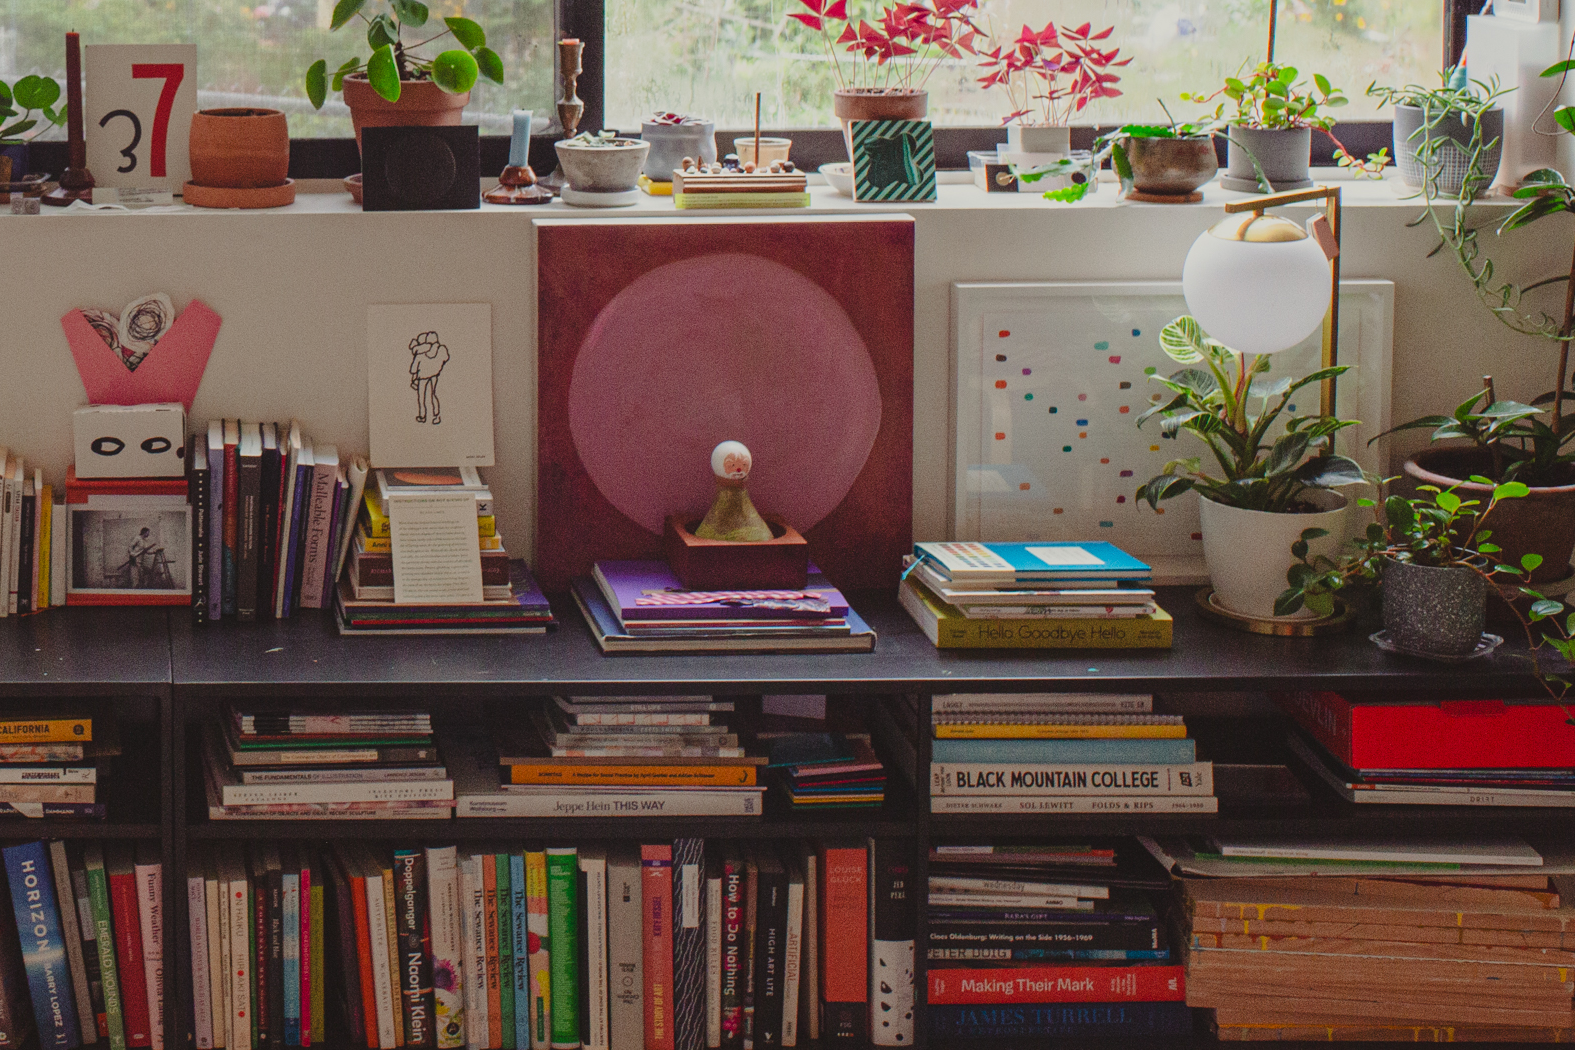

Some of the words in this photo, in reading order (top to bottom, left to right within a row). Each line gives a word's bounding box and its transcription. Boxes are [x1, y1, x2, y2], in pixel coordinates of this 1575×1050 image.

[98, 109, 142, 173] 3
[131, 63, 184, 177] 7
[312, 472, 330, 526] Malleable
[309, 528, 323, 563] Forms
[978, 624, 1013, 640] Hello
[1018, 624, 1086, 644] Goodbye
[1090, 625, 1126, 640] Hello
[264, 773, 311, 781] FUNDAMENTALS
[957, 771, 1006, 788] BLACK
[1011, 771, 1087, 788] MOUNTAIN
[1092, 771, 1159, 788] COLLEGE
[553, 801, 584, 814] Jeppe
[586, 800, 610, 811] Hein
[613, 800, 639, 811] THIS
[641, 800, 666, 810] WAY
[1470, 795, 1495, 803] DRIFT
[147, 873, 158, 903] Funny
[403, 858, 416, 930] Doppelganger
[474, 889, 482, 907] The
[487, 888, 495, 906] The
[500, 888, 508, 906] The
[515, 890, 523, 908] The
[728, 874, 739, 903] How
[983, 880, 1025, 893] wednesday
[21, 859, 51, 951] HORIZON
[727, 906, 739, 919] to
[150, 906, 161, 945] Weather
[272, 918, 280, 933] Black
[475, 911, 483, 952] Sewanee
[488, 910, 497, 951] Sewanee
[516, 912, 524, 953] Sewanee
[949, 933, 988, 942] Oldenburg:
[989, 933, 1013, 942] Writing
[97, 920, 112, 968] EMERALD
[272, 934, 280, 945] and
[767, 928, 776, 954] HIGH
[766, 957, 775, 974] ART
[787, 931, 798, 982] ARTIFICIAL
[44, 962, 57, 994] BARRY
[408, 952, 424, 1002] Naomi
[476, 955, 484, 990] Review
[489, 954, 498, 989] Review
[502, 954, 510, 989] Review
[517, 956, 525, 991] Review
[724, 945, 738, 996] Nothing
[103, 970, 118, 1015] WOUNDS
[653, 983, 663, 996] ART
[765, 977, 774, 997] LITE
[961, 979, 1014, 995] Making
[1016, 978, 1054, 992] Their
[1056, 977, 1095, 991] Mark
[50, 996, 63, 1027] LOPEZ
[653, 997, 663, 1006] OF
[410, 1005, 426, 1042] Klein
[653, 1007, 663, 1027] STORY
[956, 1008, 1024, 1025] JAMES
[1036, 1007, 1132, 1024] TURRELL
[654, 1028, 664, 1040] THE
